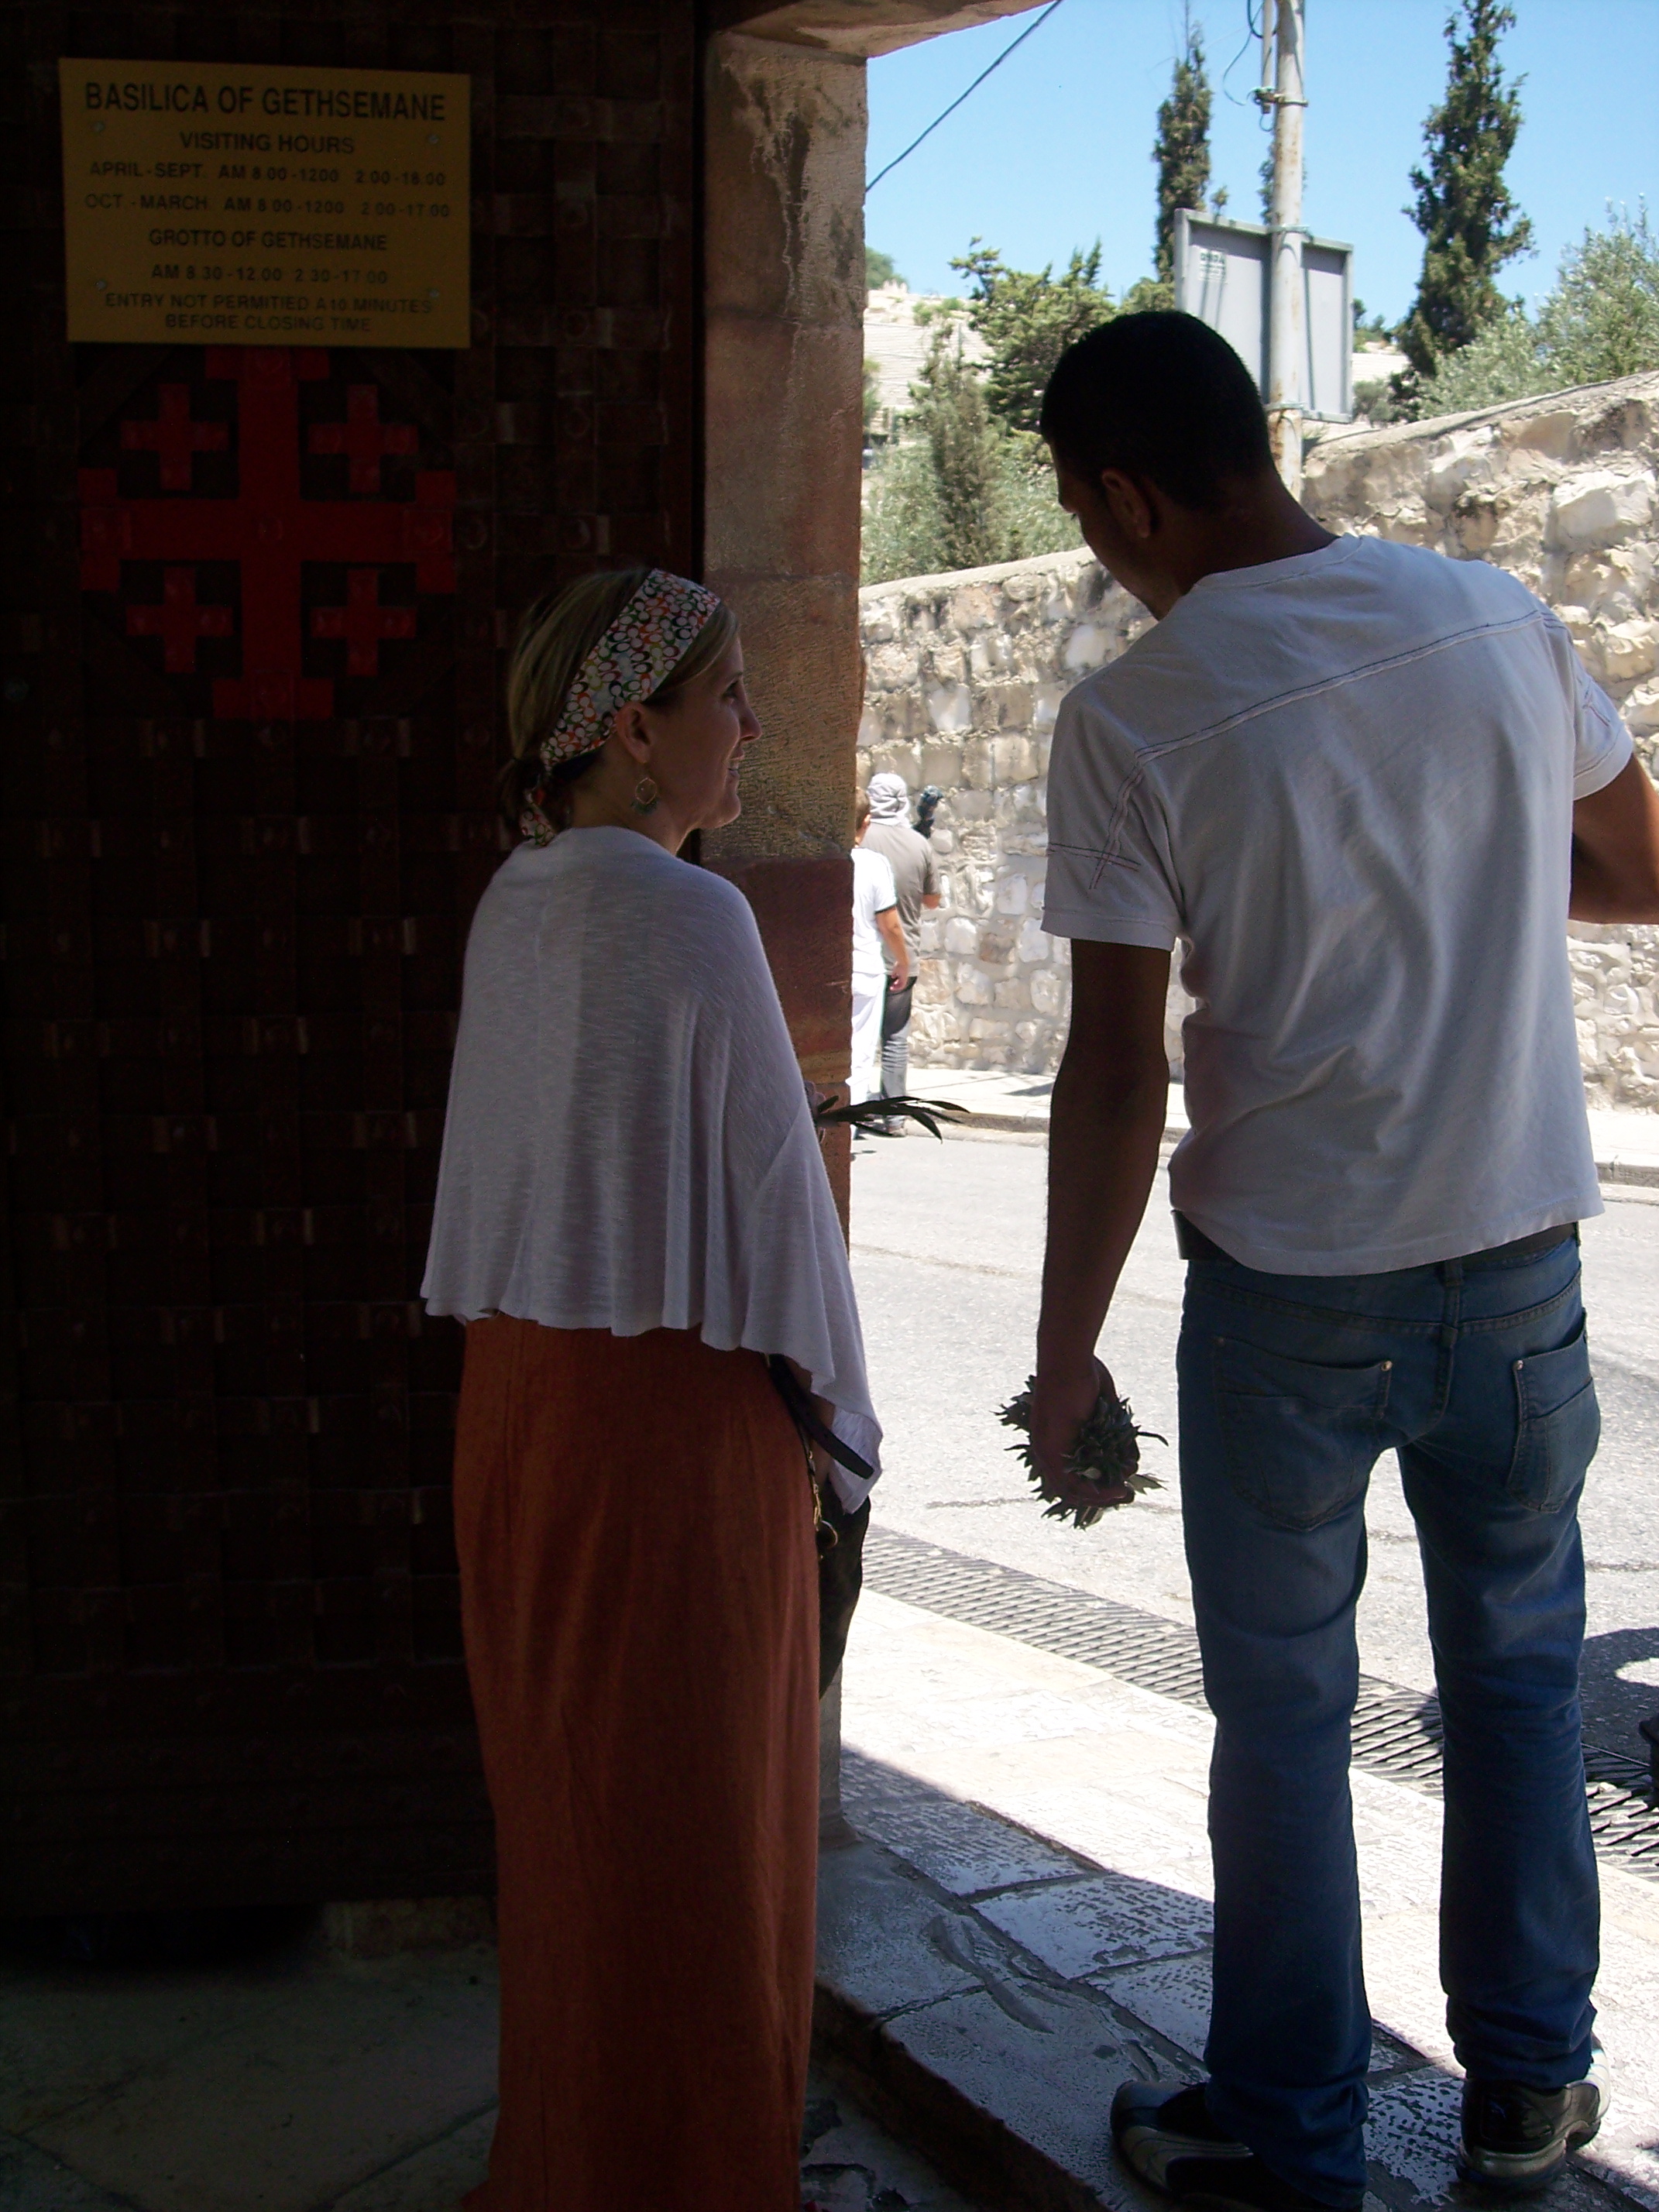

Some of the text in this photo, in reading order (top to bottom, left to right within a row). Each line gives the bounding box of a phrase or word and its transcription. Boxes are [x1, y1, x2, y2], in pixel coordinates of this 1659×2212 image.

[85, 82, 445, 122] BASILICA OF GETHSEMANE
[180, 131, 355, 154] VISITING HOURS
[218, 164, 246, 179] AM
[225, 197, 252, 211] AM
[149, 228, 387, 251] GROTTO OF GETHSEMANE
[151, 264, 180, 279] AM
[105, 292, 164, 307] ENTRY
[171, 294, 208, 308] NOT
[353, 298, 432, 314] MINUTES
[165, 313, 372, 331] BEFORE CLOSING TIME
